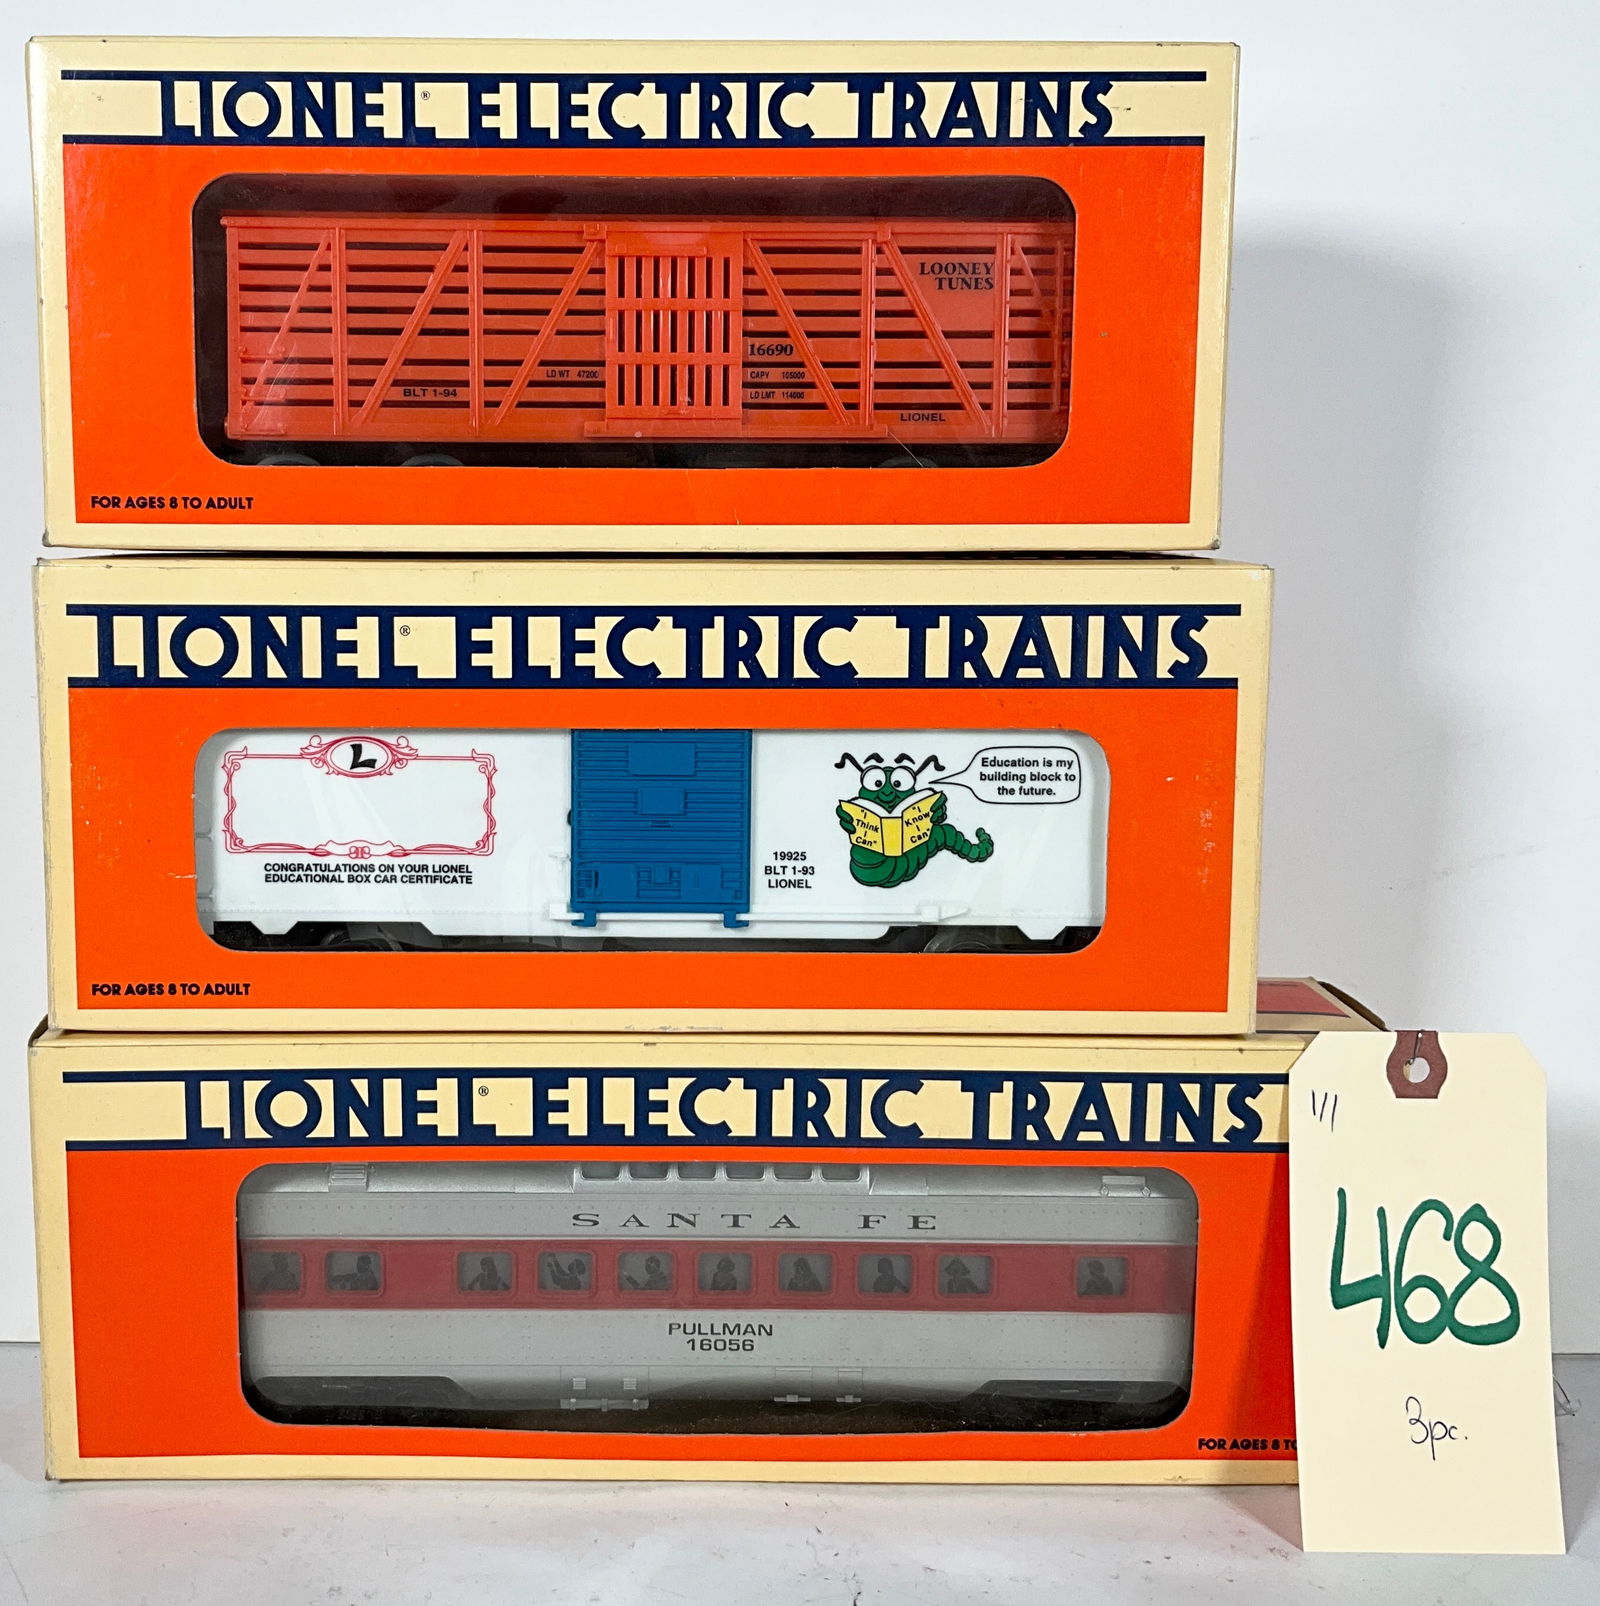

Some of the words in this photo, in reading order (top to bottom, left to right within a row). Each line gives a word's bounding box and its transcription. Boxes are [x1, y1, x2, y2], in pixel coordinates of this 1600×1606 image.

[469, 76, 815, 142] ELECTRIC
[848, 76, 1113, 141] TRAINS
[919, 262, 994, 275] LOONEY
[935, 277, 994, 290] TUNES
[749, 344, 793, 356] 16690
[546, 370, 556, 378] LD
[558, 370, 569, 378] WT
[750, 371, 769, 379] CAPY
[403, 389, 427, 397] BLT
[432, 389, 457, 397] 1-94
[750, 391, 759, 399] LD
[761, 391, 775, 399] LMT
[900, 413, 945, 421] LIONEL
[91, 496, 121, 508] FOR
[125, 496, 165, 508] AGES
[169, 496, 178, 509] 8
[182, 497, 202, 509] TO
[206, 497, 253, 509] ADULT
[456, 611, 858, 682] ELECTRIC
[895, 611, 1208, 682] TRAINS
[981, 756, 1039, 767] Education
[1043, 757, 1052, 767] is
[1056, 760, 1073, 769] my
[980, 771, 1026, 783] building
[1030, 772, 1061, 781] block
[1065, 773, 1076, 781] to
[997, 786, 1015, 795] the
[1019, 786, 1056, 795] future.
[856, 818, 879, 832] Think
[905, 811, 930, 827] Know
[773, 851, 807, 861] 19925
[264, 863, 375, 873] CONGRATULATIONS
[378, 864, 394, 873] ON
[398, 864, 428, 873] YOUR
[432, 864, 472, 873] LIONEL
[765, 866, 787, 875] BLT
[792, 866, 815, 875] 1-93
[264, 874, 344, 883] EDUCATIONAL
[348, 874, 370, 883] BOX
[374, 874, 397, 883] CAR
[400, 875, 473, 884] CERTIFICATE
[768, 879, 812, 888] LIONEL
[92, 984, 121, 996] FOR
[125, 983, 164, 996] AGES
[168, 983, 177, 996] 8
[180, 983, 200, 996] TO
[204, 983, 250, 996] ADULT
[532, 1073, 924, 1142] ELECTRIC
[961, 1078, 1264, 1145] TRAINS
[571, 1212, 801, 1229] SANTA
[857, 1214, 936, 1230] FE
[1330, 1187, 1520, 1349] 468
[668, 1322, 773, 1336] PULLMAN
[686, 1338, 755, 1351] 16056
[1198, 1438, 1227, 1450] FOR
[1230, 1439, 1268, 1450] AGES
[1271, 1439, 1280, 1450] 8
